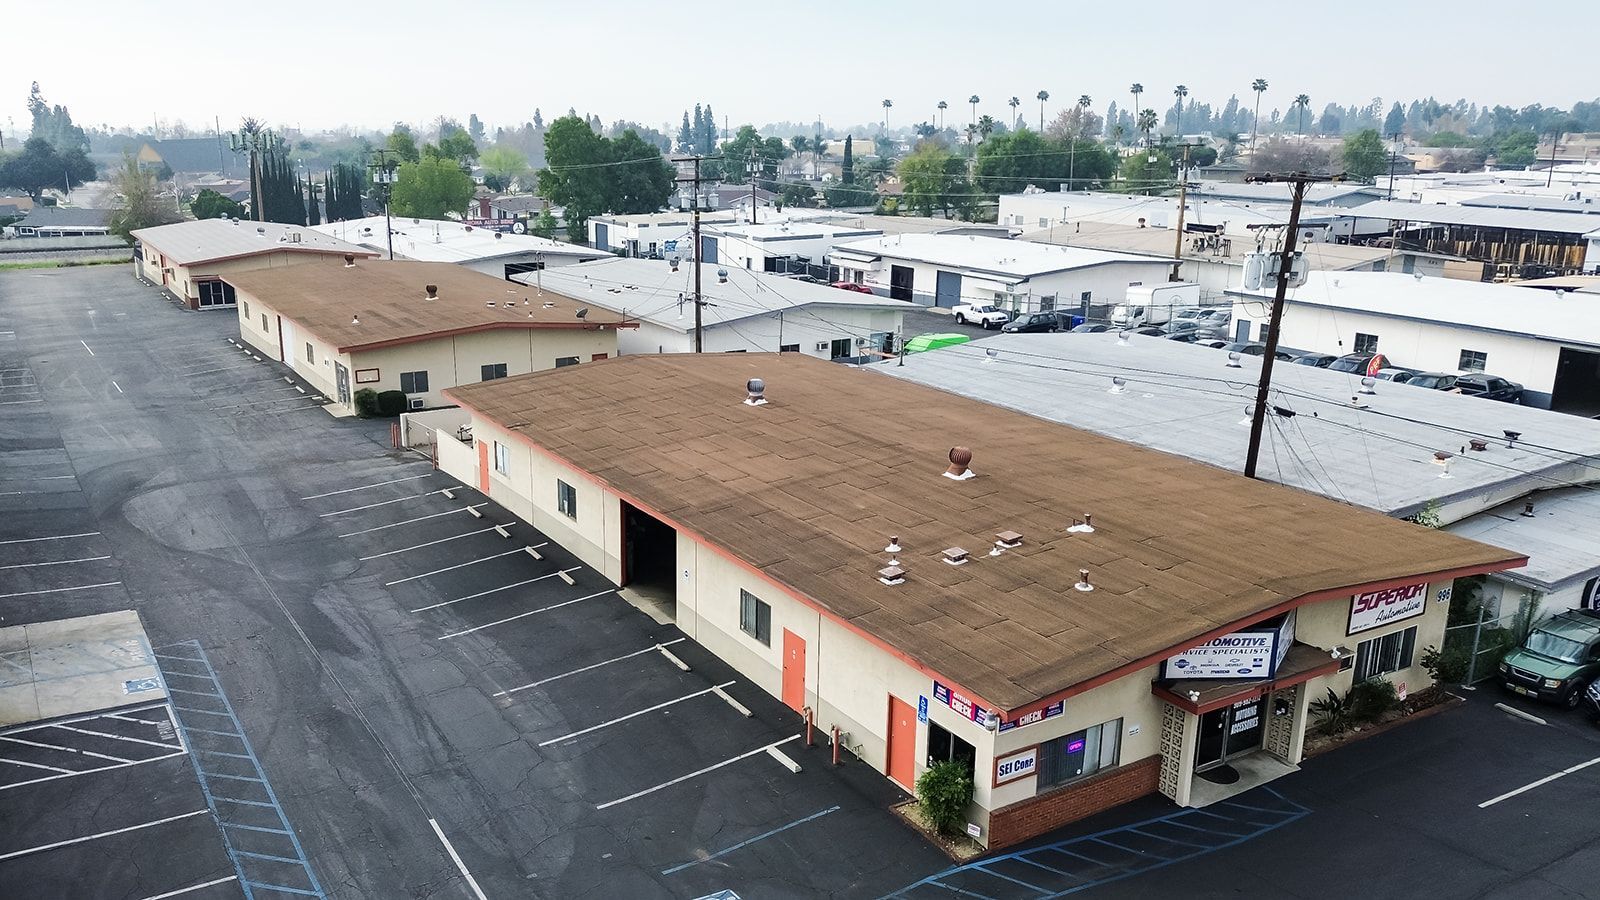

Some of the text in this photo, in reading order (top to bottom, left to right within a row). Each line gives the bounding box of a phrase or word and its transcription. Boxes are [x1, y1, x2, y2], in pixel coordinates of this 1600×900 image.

[1354, 583, 1424, 614] SUPERIOR
[1437, 588, 1451, 602] 996
[1375, 600, 1421, 624] Automotive
[1199, 637, 1268, 647] OMOTIVE
[952, 698, 972, 719] CHECK
[1019, 710, 1042, 726] CHECK
[1069, 742, 1082, 750] OPEN
[999, 763, 1013, 777] SEI
